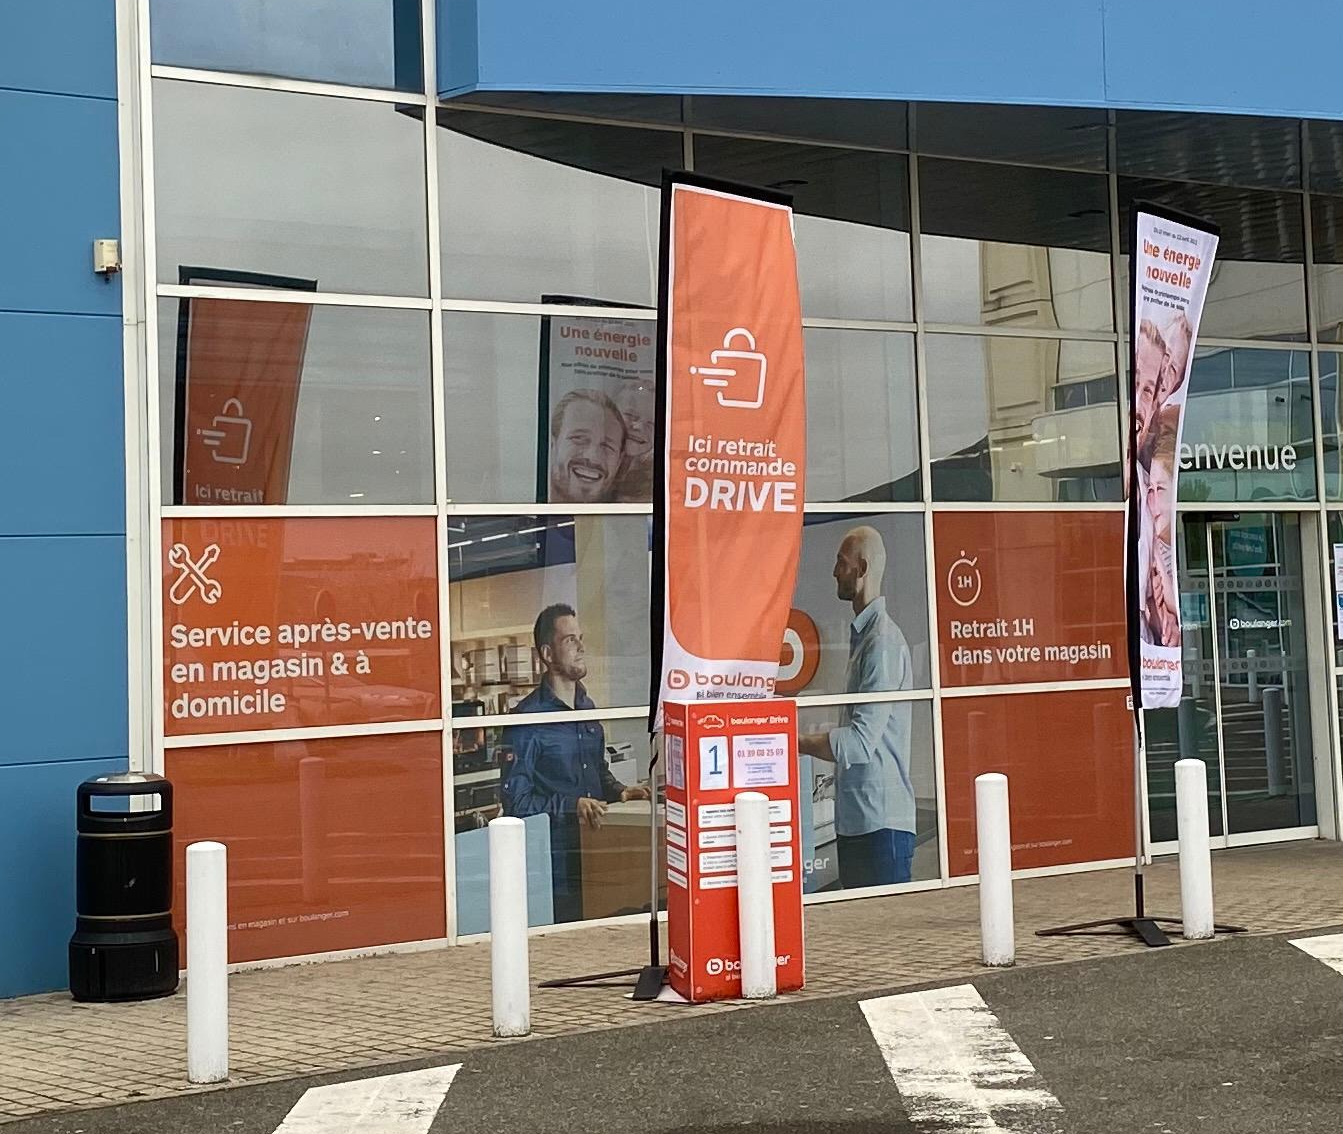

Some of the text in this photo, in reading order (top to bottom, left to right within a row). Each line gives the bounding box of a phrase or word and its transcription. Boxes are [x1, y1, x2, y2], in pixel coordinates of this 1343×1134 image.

[560, 326, 652, 348] Une énergie
[575, 345, 639, 363] nouvelle
[688, 434, 777, 458] Ici retrait
[1178, 442, 1297, 470] envenue
[684, 456, 797, 477] commande
[196, 484, 264, 504] Ici retrait
[683, 476, 798, 513] DRIVE
[957, 575, 972, 588] 1H
[171, 617, 432, 648] Service après-vente
[950, 618, 1034, 639] Retrait 1H
[952, 641, 1112, 665] dans votre magasin
[171, 650, 371, 684] en magasin & à
[695, 672, 776, 692] boulang
[171, 690, 287, 718] domicile
[708, 745, 723, 775] 1
